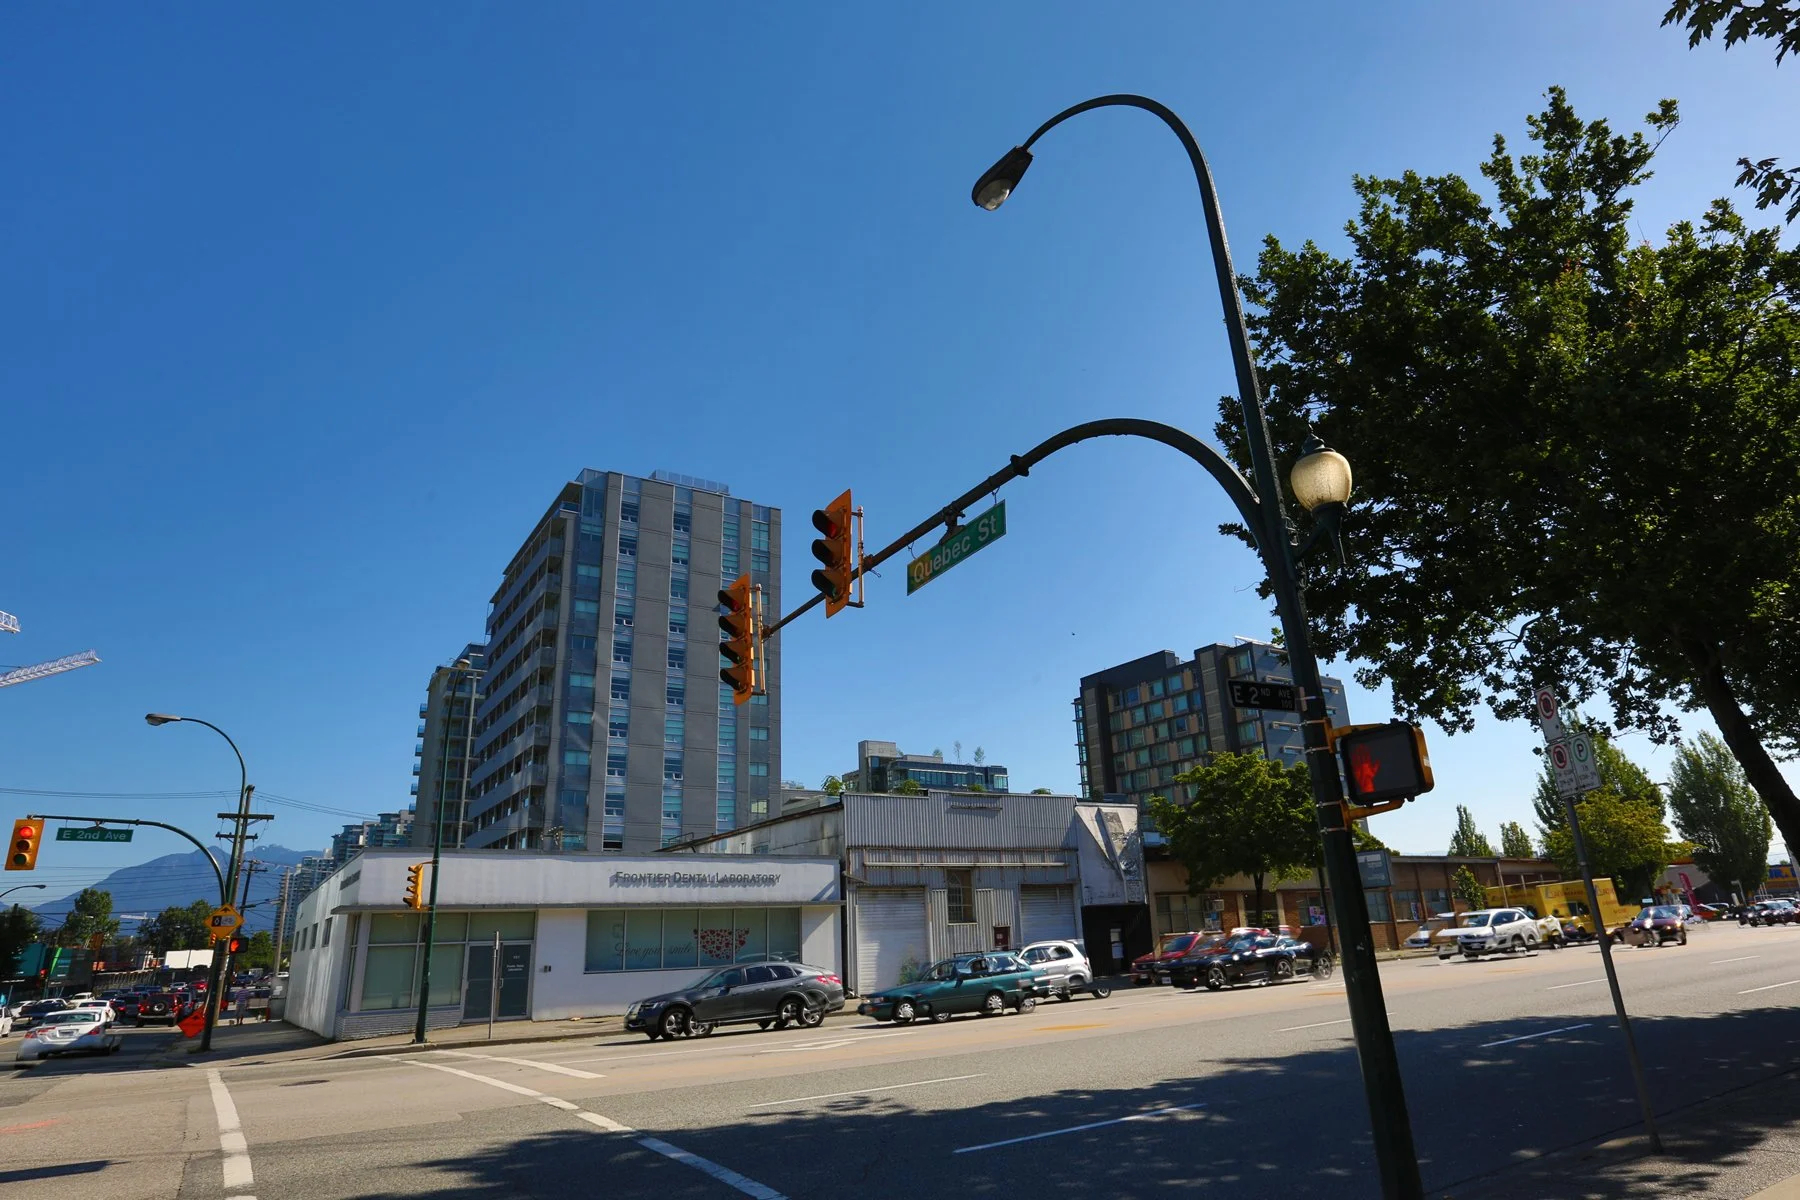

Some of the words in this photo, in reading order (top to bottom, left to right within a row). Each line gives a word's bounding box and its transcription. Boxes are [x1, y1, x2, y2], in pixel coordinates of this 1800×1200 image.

[914, 536, 971, 583] Quebec
[978, 515, 996, 542] St
[1232, 685, 1244, 704] E
[1278, 688, 1292, 699] AVE
[62, 830, 72, 839] E
[76, 831, 101, 840] 2nd
[104, 831, 126, 840] Ave
